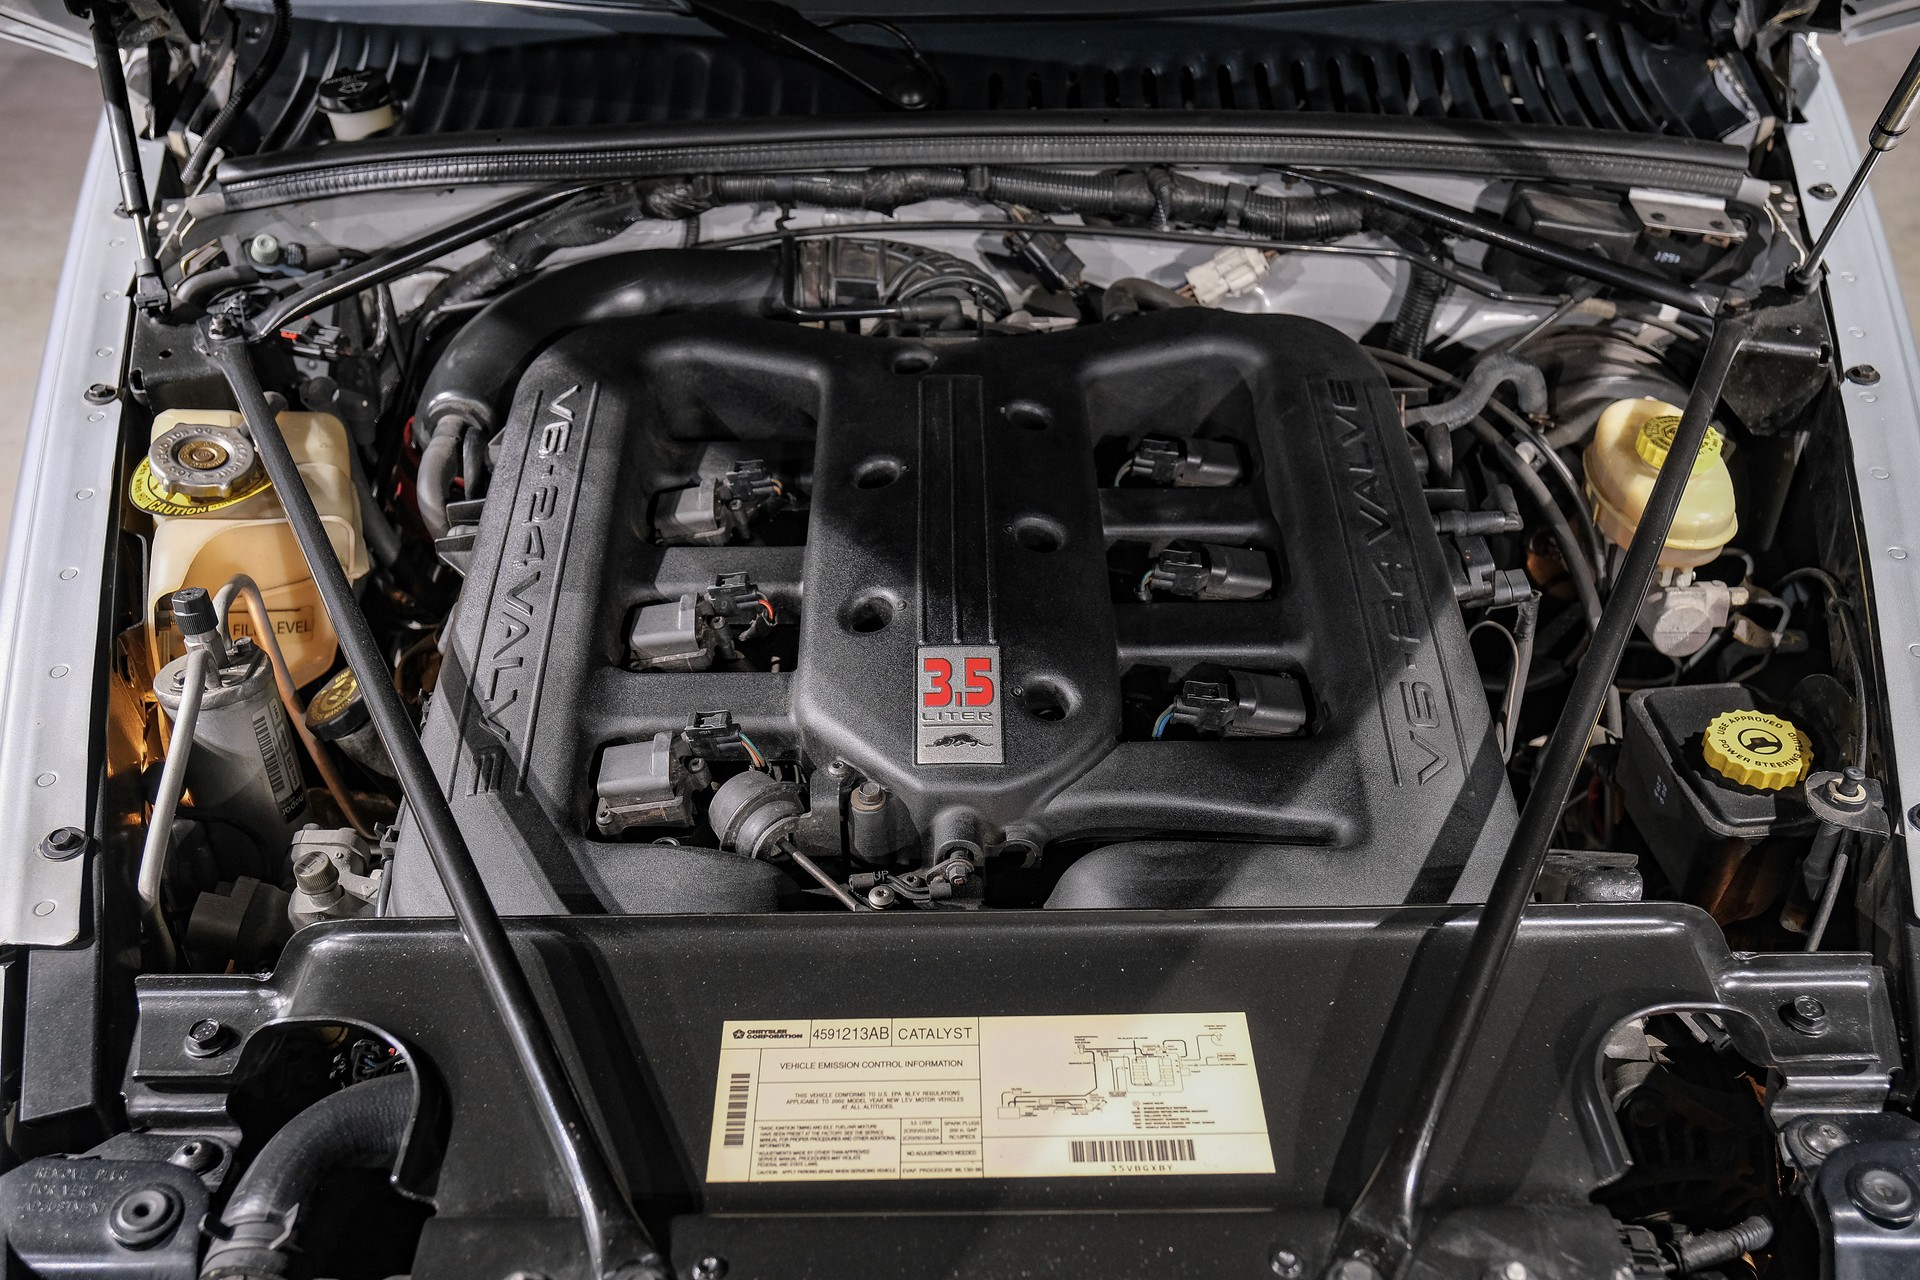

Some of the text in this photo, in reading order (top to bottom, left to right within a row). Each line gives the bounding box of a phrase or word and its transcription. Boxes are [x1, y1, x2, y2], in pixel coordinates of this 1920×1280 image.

[148, 500, 207, 515] CAUTION
[923, 657, 994, 707] 3.5
[920, 711, 993, 721] LITER
[1717, 716, 1783, 735] USE APPROVED
[1718, 739, 1751, 763] POWER
[1755, 753, 1802, 768] STEERING
[812, 1026, 889, 1040] 4591213AB
[898, 1027, 972, 1040] CATALYST
[780, 1059, 963, 1070] VEHICLE EMISSION CONTROL INFORMATION
[35, 1167, 129, 1181] REMOVE PLUG
